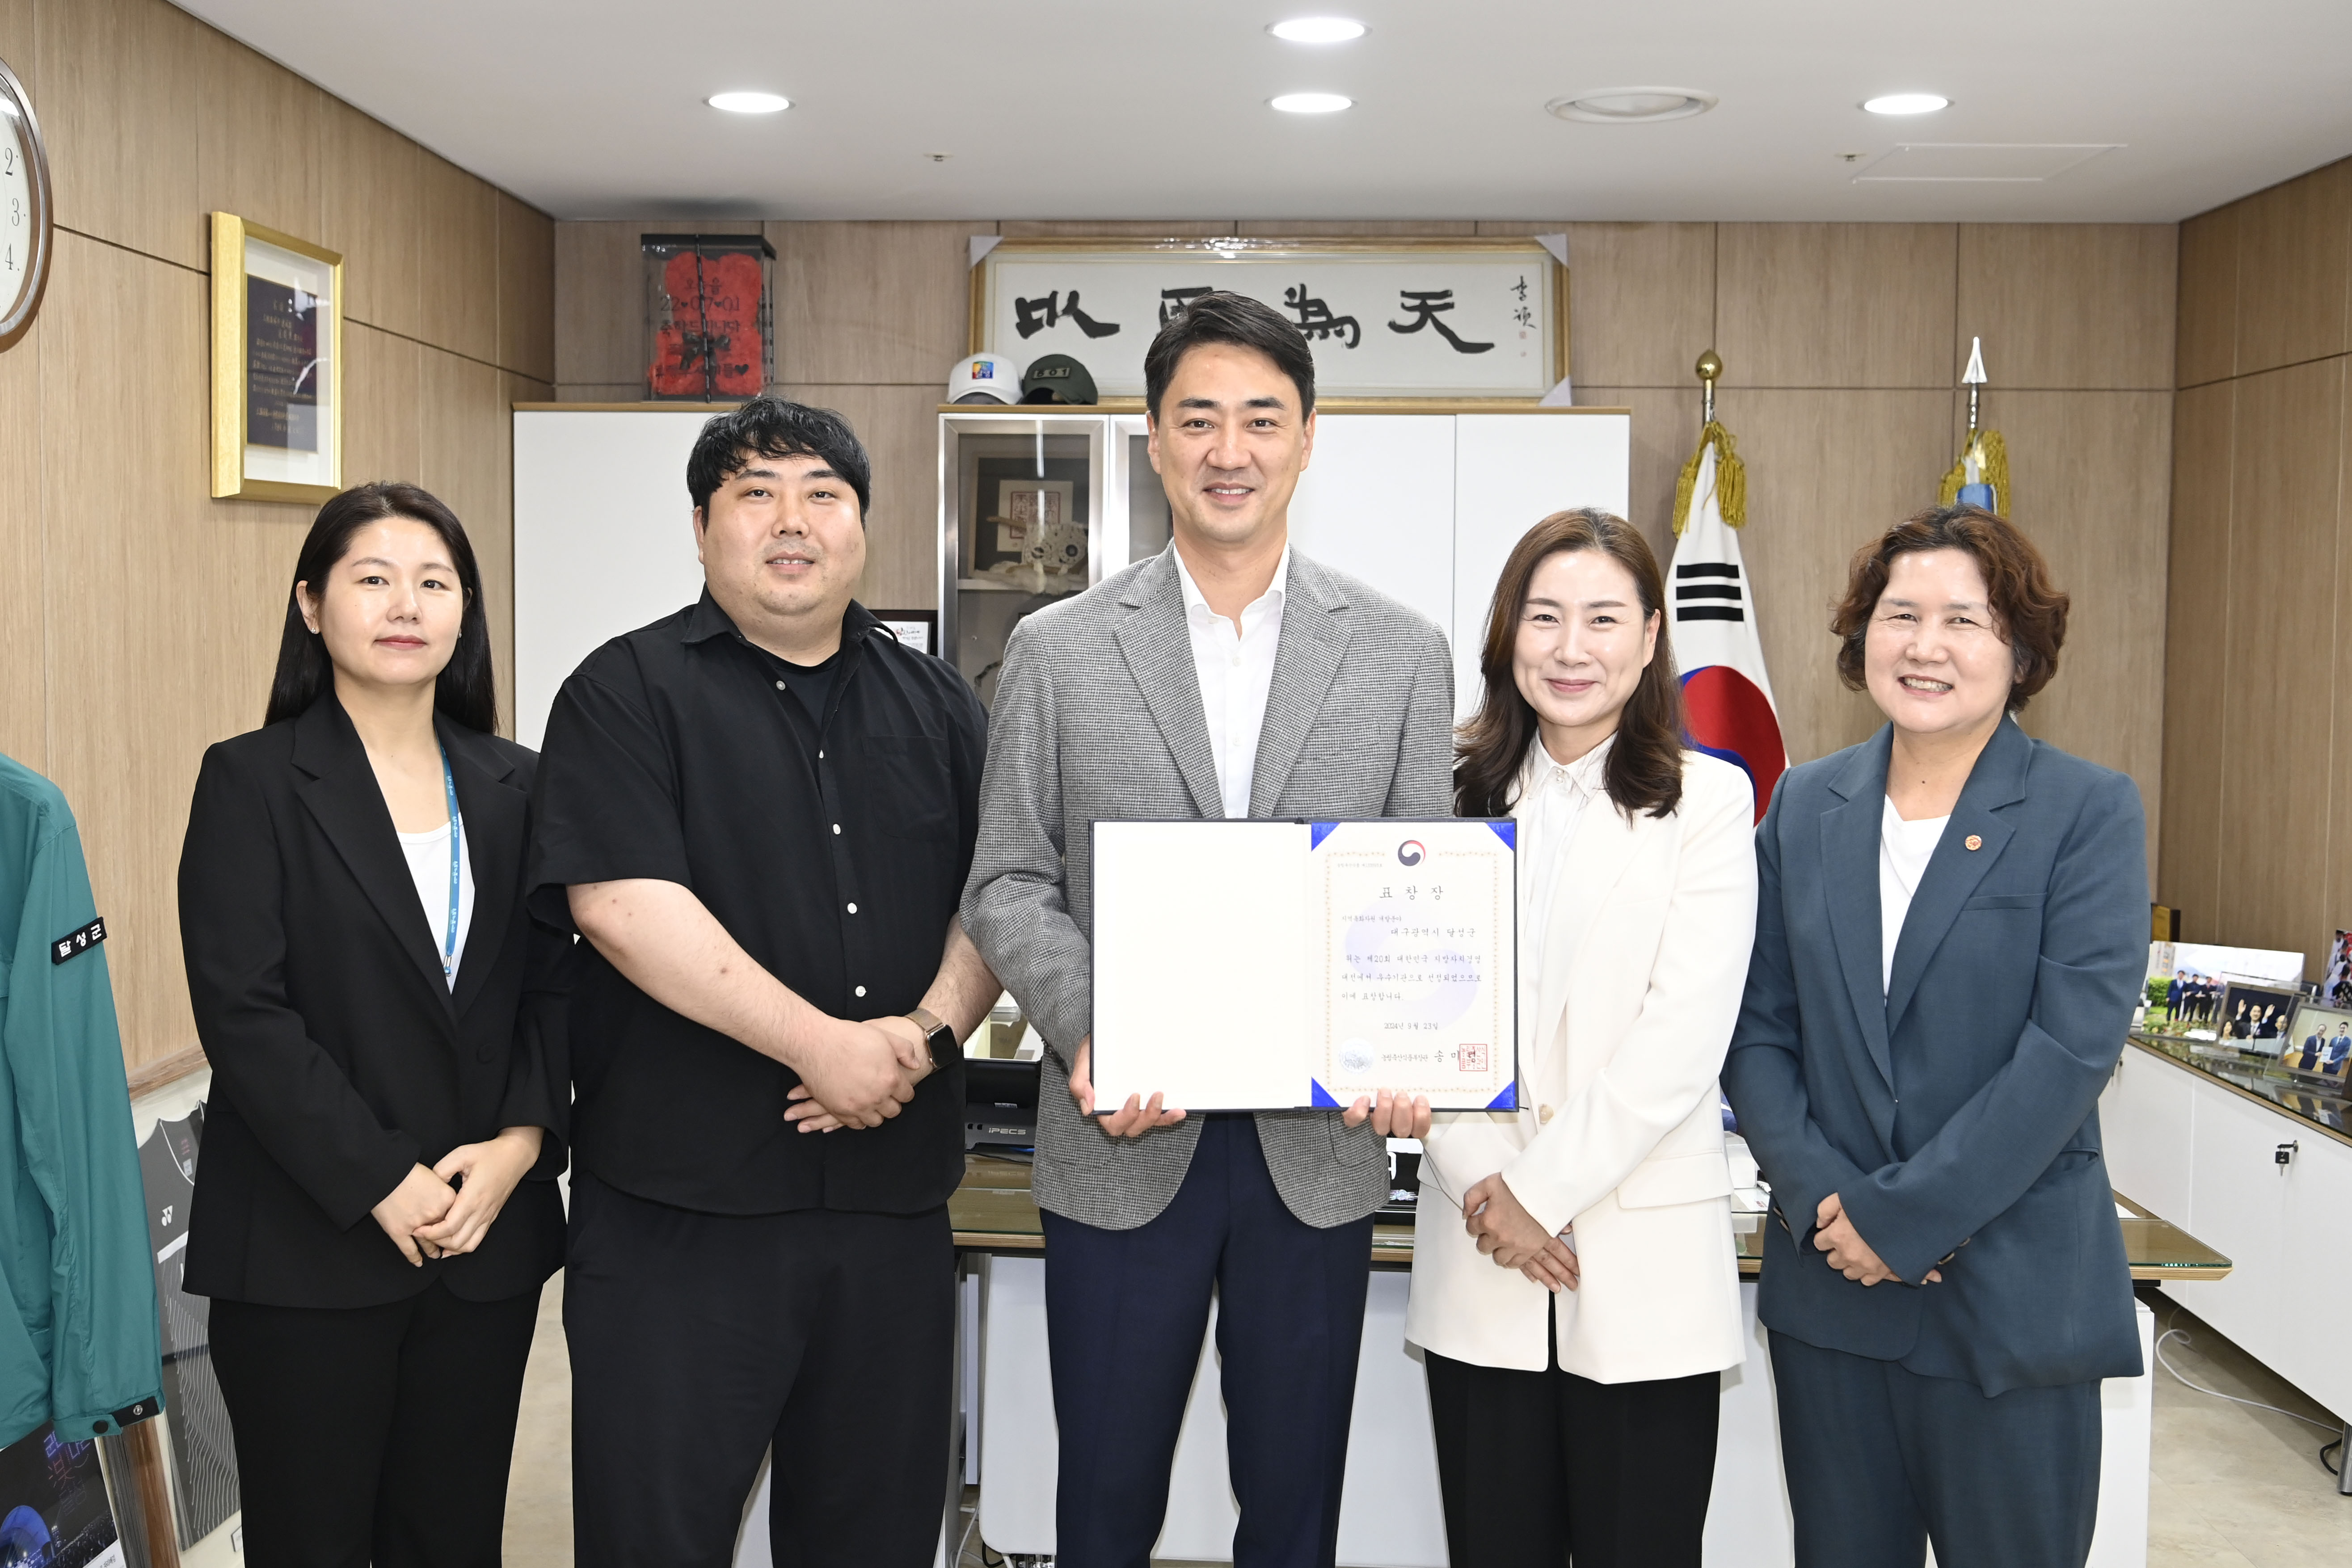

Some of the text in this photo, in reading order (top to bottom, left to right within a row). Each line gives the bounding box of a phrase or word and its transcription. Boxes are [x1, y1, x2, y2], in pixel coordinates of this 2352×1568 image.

[5, 148, 13, 176] 2
[12, 198, 20, 226] 3
[5, 243, 13, 270] 4
[1391, 927, 1476, 938] 대구광역시 달성군
[59, 923, 102, 957] 달성군
[1346, 954, 1480, 964] 위는 제20회 대한민국 지방자치경영
[1376, 973, 1423, 982] 우수기관으로
[1429, 973, 1482, 982] 선정되었으므로
[1341, 992, 1356, 1000] 이에
[1423, 1022, 1438, 1030] 23일
